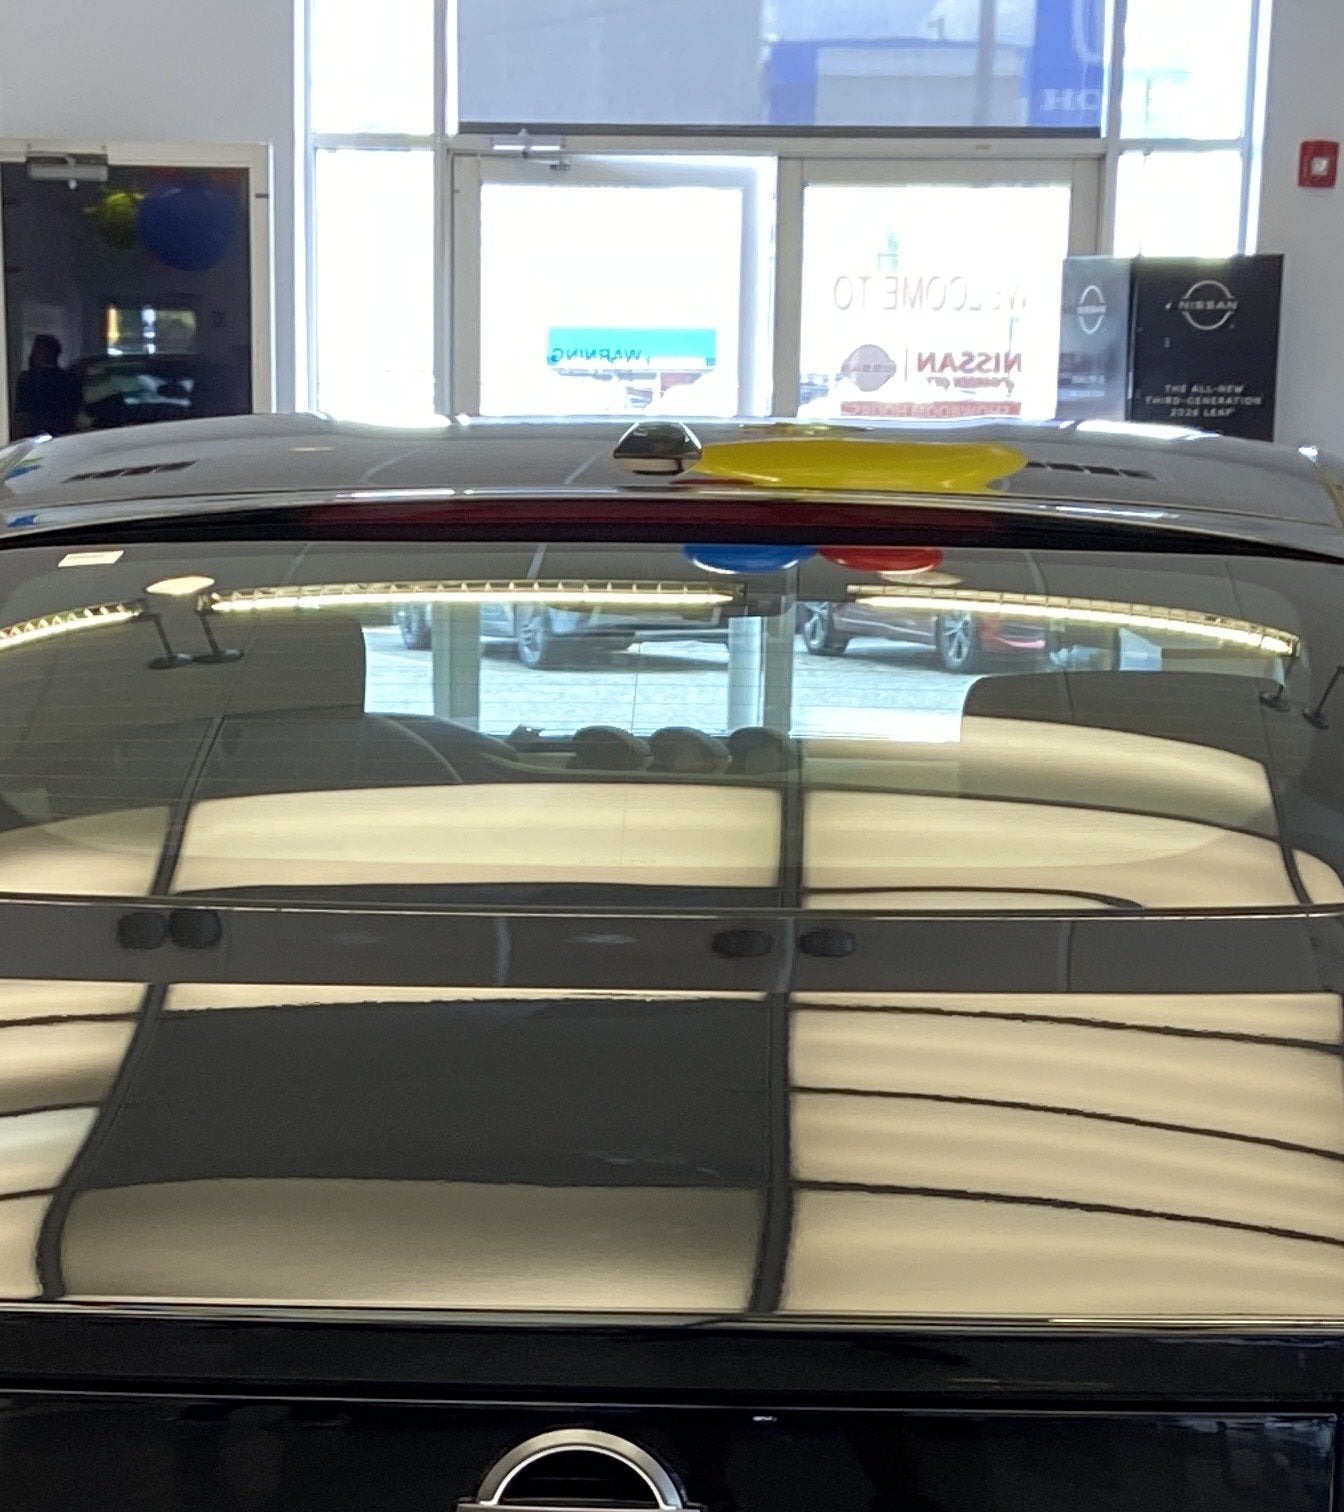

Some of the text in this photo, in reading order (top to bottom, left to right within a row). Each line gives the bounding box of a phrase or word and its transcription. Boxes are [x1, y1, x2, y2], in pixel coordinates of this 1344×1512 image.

[1178, 300, 1239, 311] NISSAN
[1165, 384, 1244, 393] THE ALL-NEW
[1146, 396, 1263, 406] THIRD-GENERATION
[1203, 408, 1236, 418] LEAF
